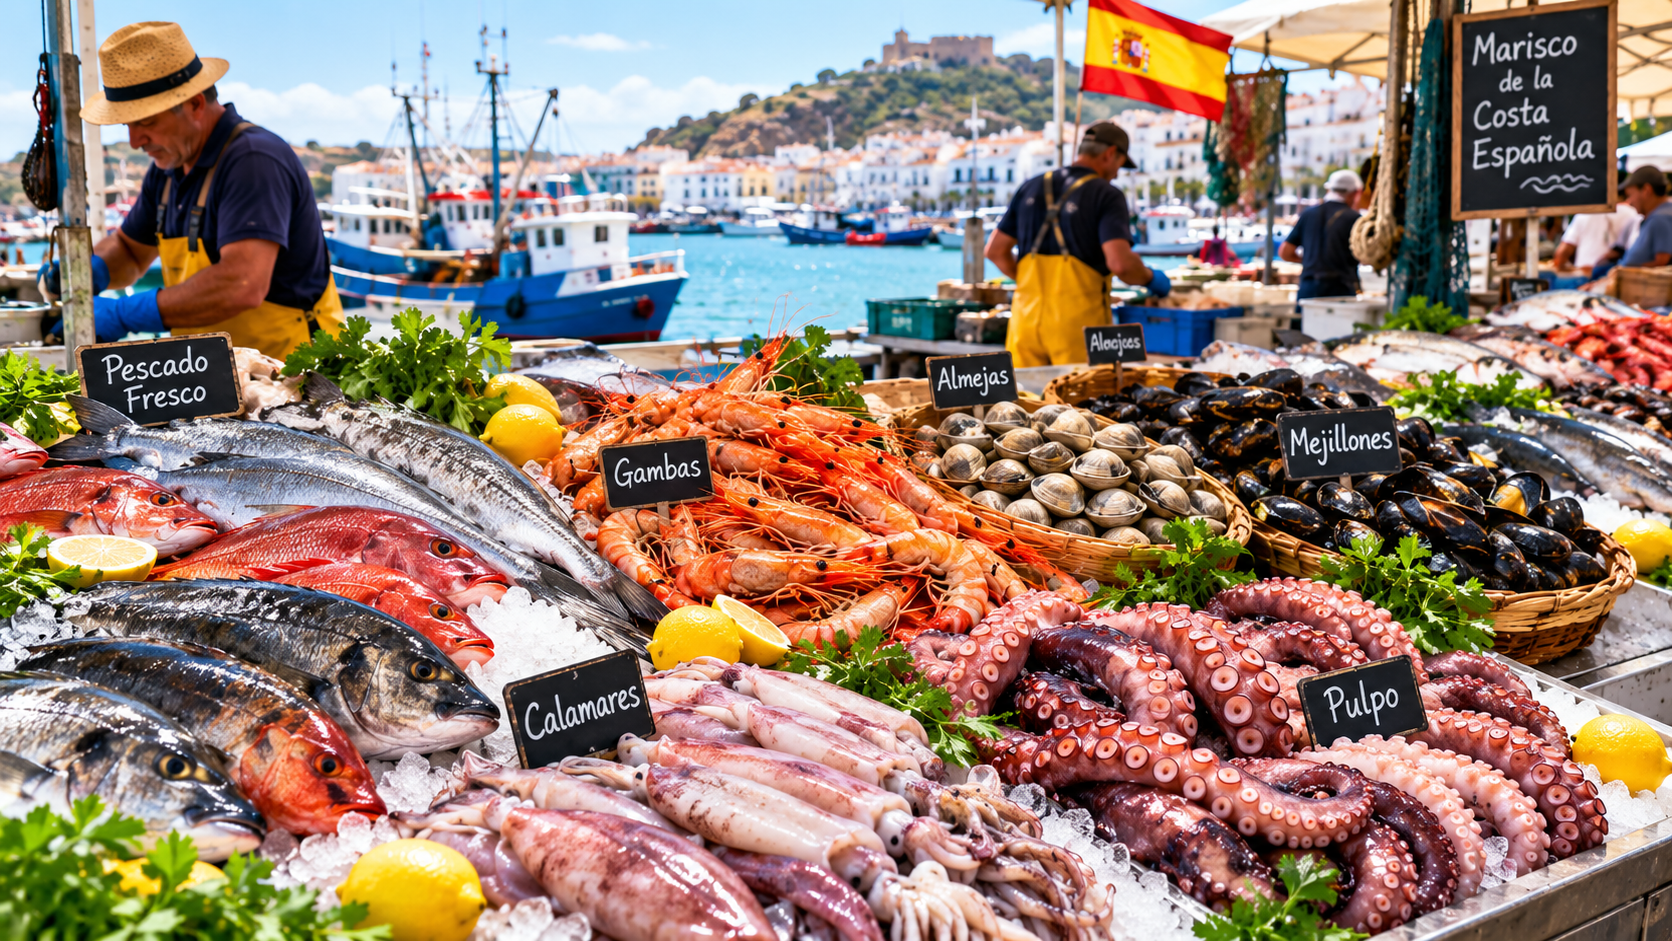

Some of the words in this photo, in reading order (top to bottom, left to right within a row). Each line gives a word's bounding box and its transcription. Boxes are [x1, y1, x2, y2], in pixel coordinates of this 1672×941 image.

[1472, 31, 1578, 66] Marisco
[1498, 68, 1524, 93] de
[1533, 64, 1554, 90] la
[1473, 97, 1550, 131] Costa
[1472, 127, 1595, 179] Española
[101, 345, 209, 384] Pescado
[937, 365, 1009, 397] Almejas
[122, 384, 207, 414] Fresco
[1289, 426, 1393, 466] Mejillones
[614, 453, 702, 487] Gambas
[524, 684, 641, 738] Calamares
[1323, 680, 1400, 726] Pulpo
